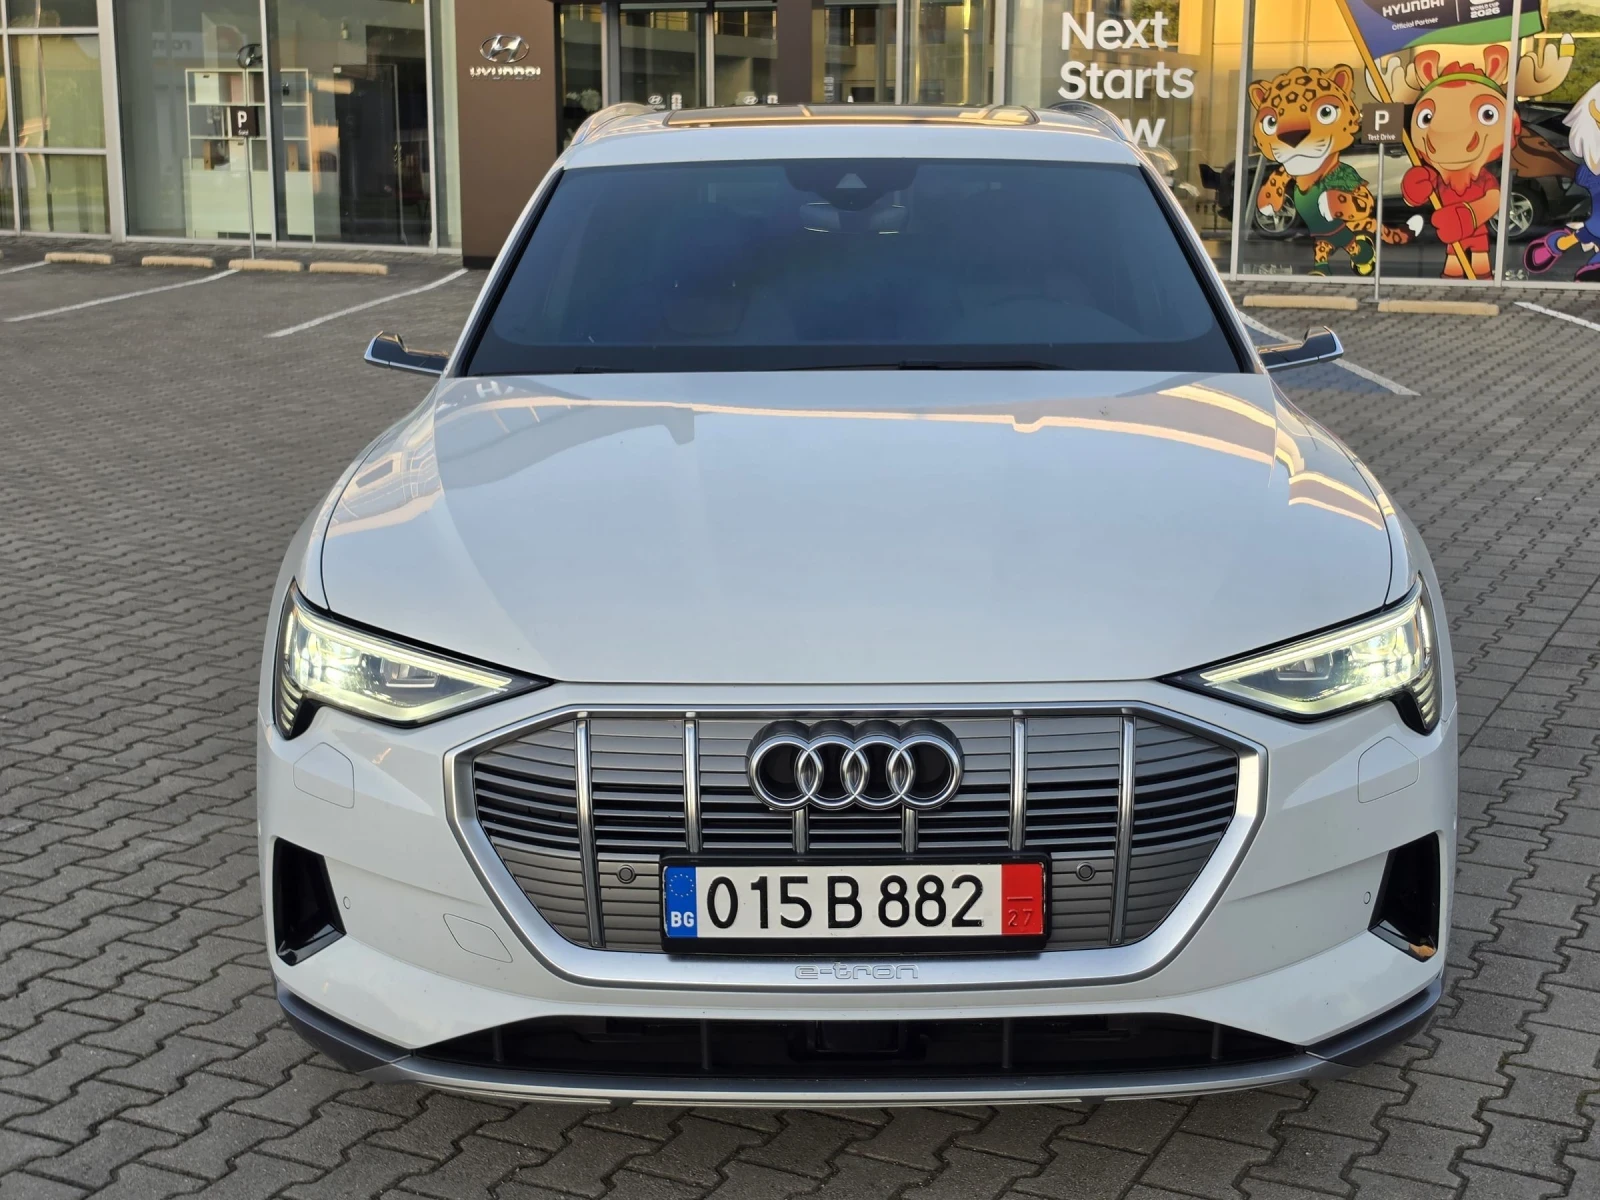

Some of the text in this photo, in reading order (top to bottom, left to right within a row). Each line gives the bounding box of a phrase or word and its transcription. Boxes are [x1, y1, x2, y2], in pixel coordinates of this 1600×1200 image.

[1470, 7, 1501, 18] 2026
[1061, 11, 1169, 50] Next
[1391, 17, 1439, 31] Official Partner
[1058, 61, 1195, 100] Starts
[238, 110, 247, 128] P
[1375, 110, 1389, 131] P
[1367, 133, 1396, 141] Test Drive
[670, 911, 695, 928] BG
[1008, 909, 1033, 926] 27
[795, 961, 918, 980] e-tron
